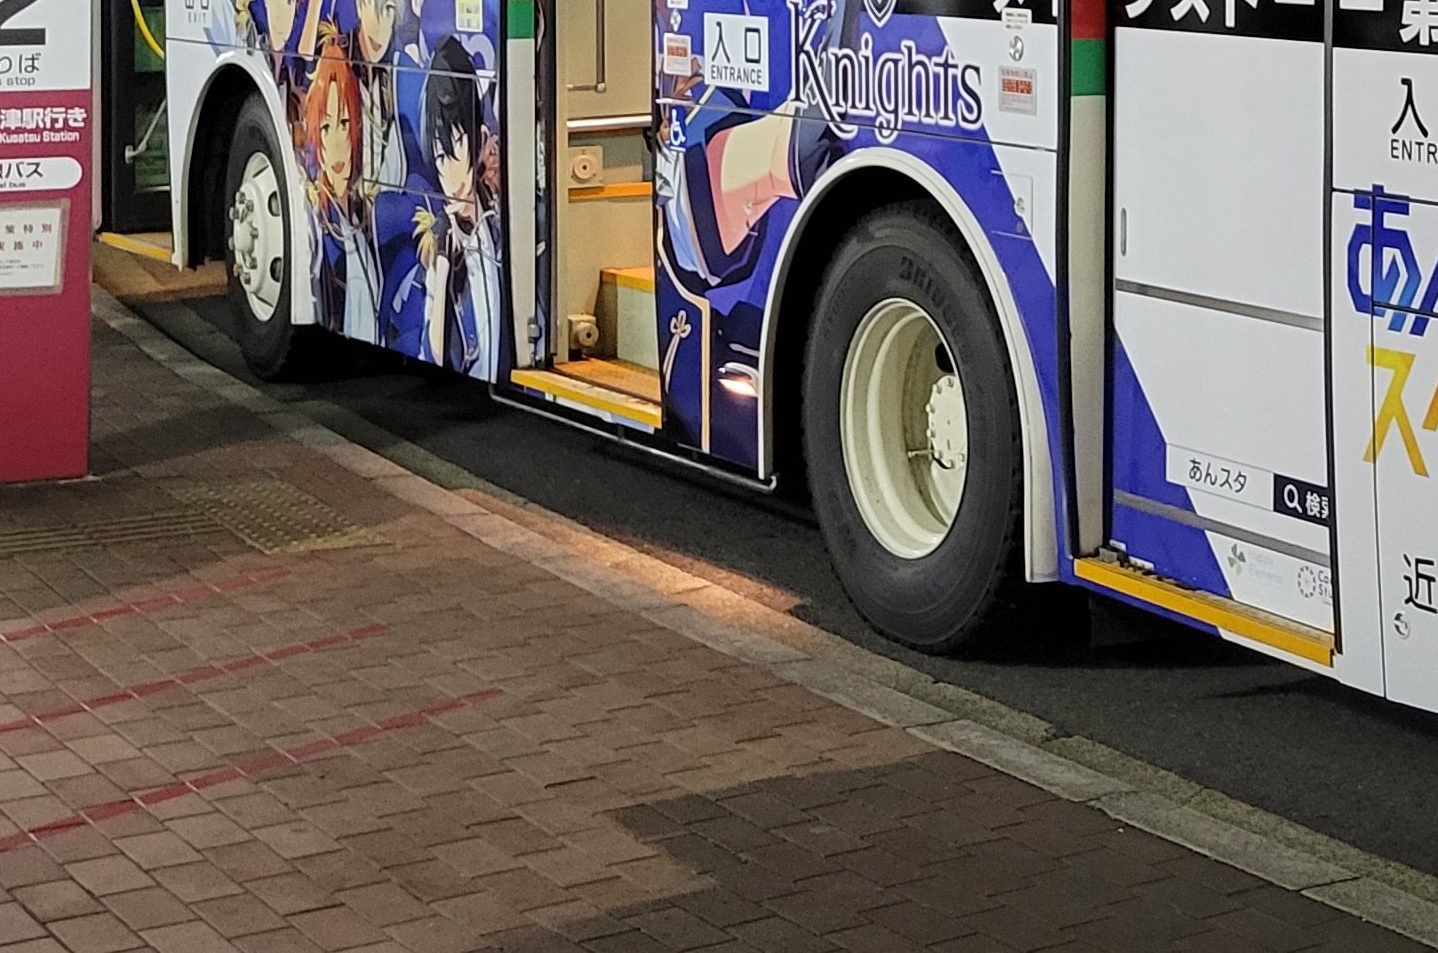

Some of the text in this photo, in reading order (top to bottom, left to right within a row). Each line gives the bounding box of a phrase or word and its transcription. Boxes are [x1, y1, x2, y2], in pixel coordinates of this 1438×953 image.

[711, 21, 761, 64] 入口
[6, 76, 36, 87] stop
[711, 65, 763, 85] ENTRANCE
[0, 107, 87, 130] 津駅行き
[42, 130, 80, 143] Station
[1189, 457, 1248, 494] あんスタ
